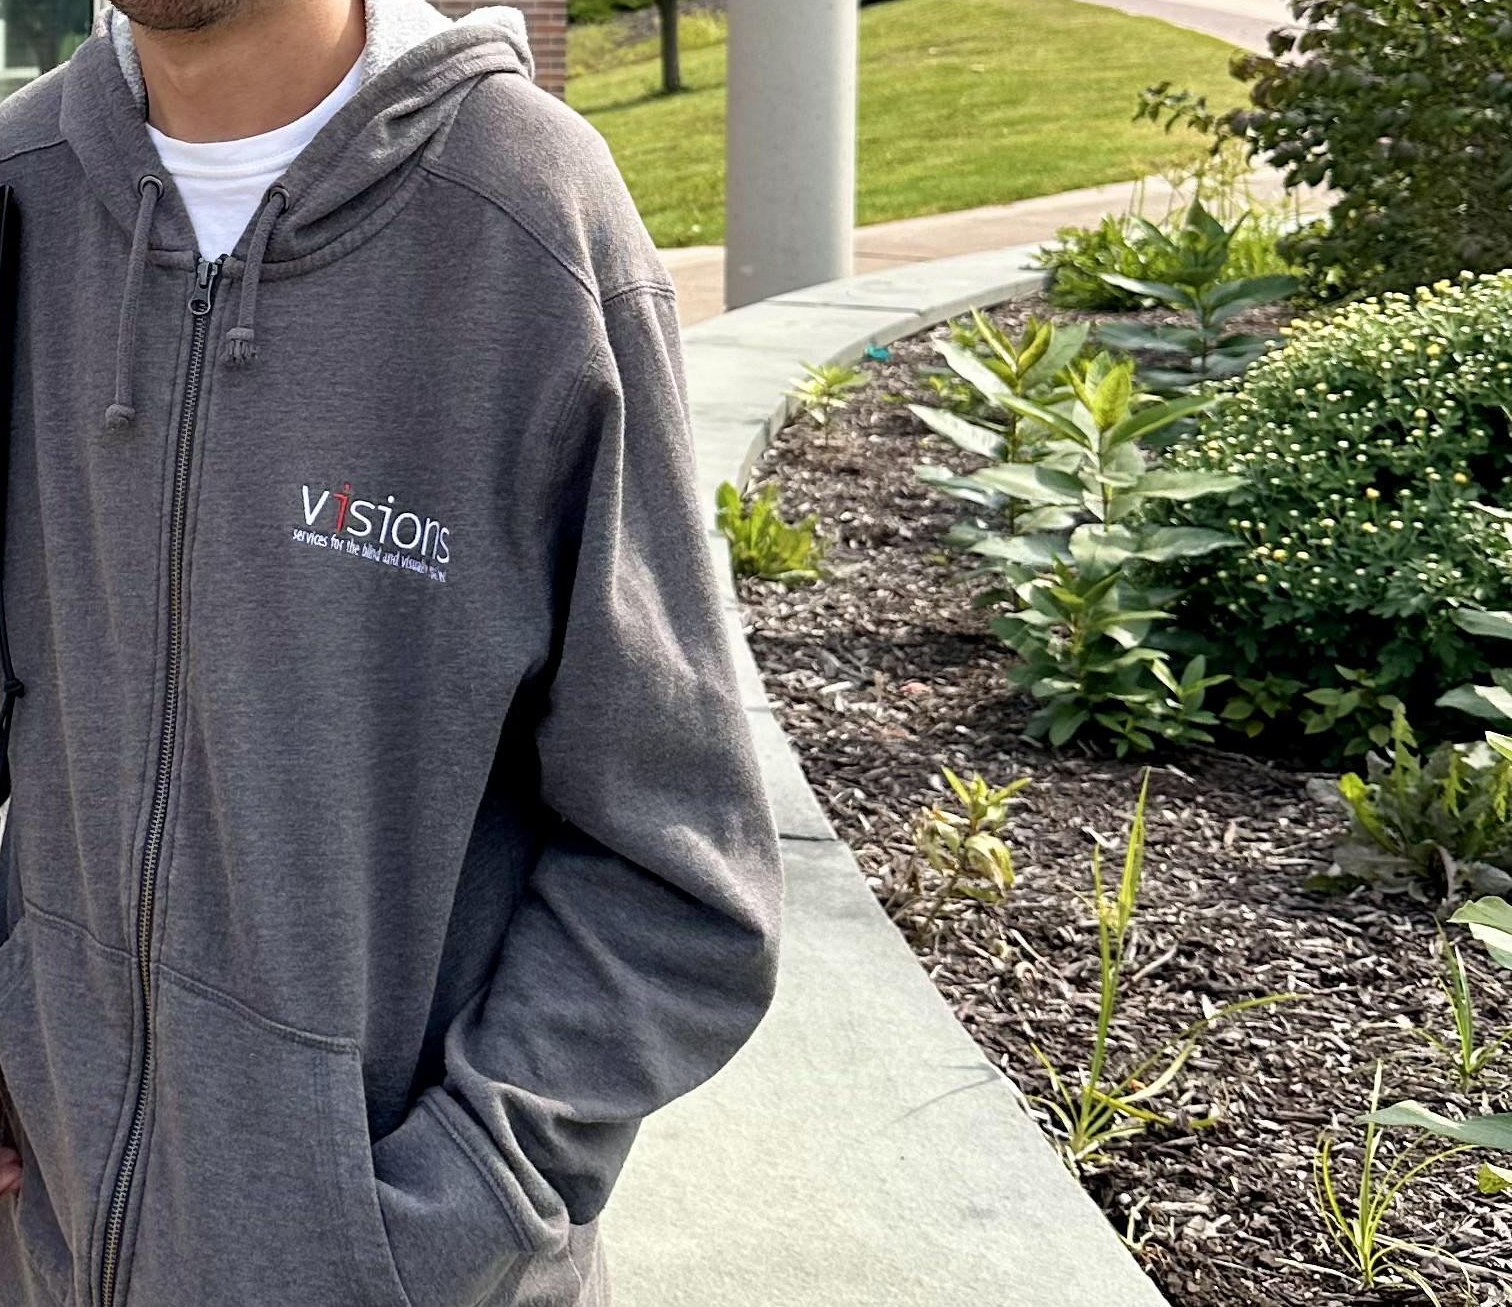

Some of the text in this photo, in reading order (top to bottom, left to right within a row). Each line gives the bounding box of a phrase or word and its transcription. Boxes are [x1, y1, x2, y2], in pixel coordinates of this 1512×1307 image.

[292, 528, 328, 547] services
[331, 534, 344, 551] for
[346, 537, 360, 556] the
[361, 542, 382, 562] blind
[382, 550, 400, 566] and
[301, 481, 450, 564] visions
